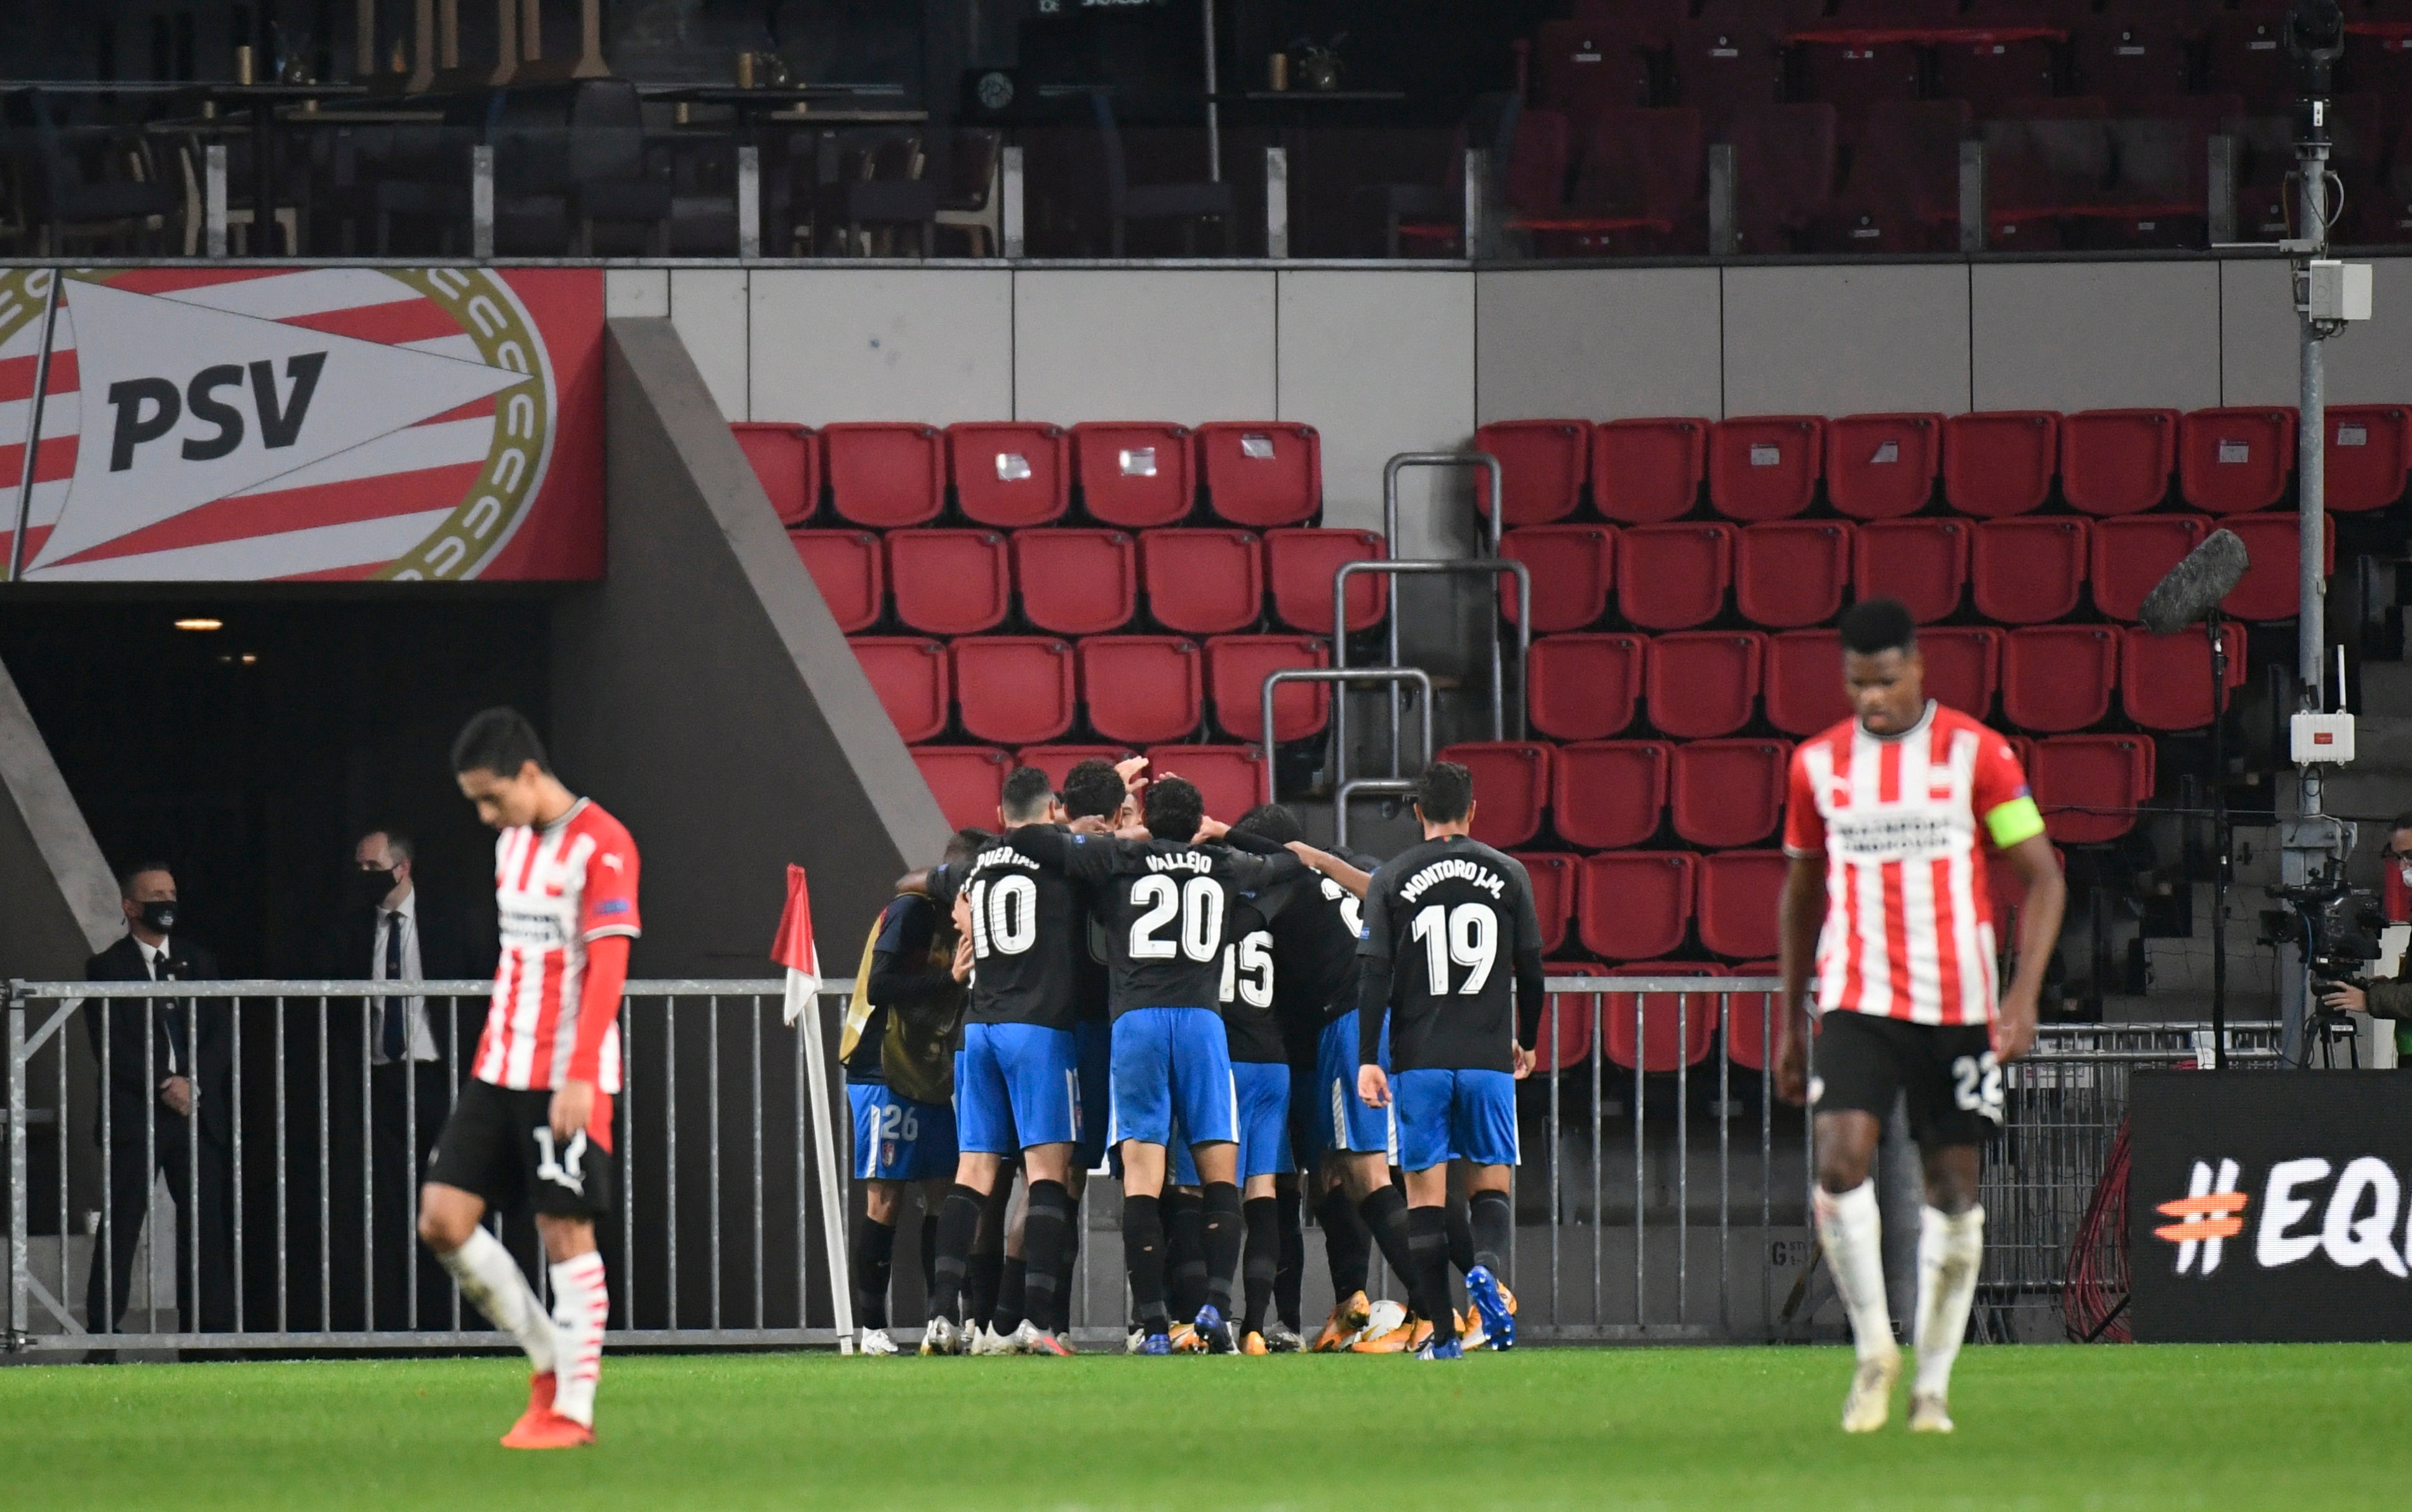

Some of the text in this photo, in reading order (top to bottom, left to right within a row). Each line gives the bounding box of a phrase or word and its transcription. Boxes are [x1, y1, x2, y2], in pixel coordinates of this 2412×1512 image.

[107, 351, 328, 473] PSV
[1145, 851, 1212, 874] VALLEJO
[1400, 859, 1478, 904] MONTORO
[970, 874, 1037, 960] 10
[1129, 874, 1224, 963] 20
[1412, 902, 1498, 996] 19
[1219, 930, 1274, 1008] 15
[1951, 1050, 2005, 1111] 22
[881, 1104, 918, 1141] 26
[1772, 1241, 1787, 1266] G
[2154, 1156, 2412, 1279] #EQ
